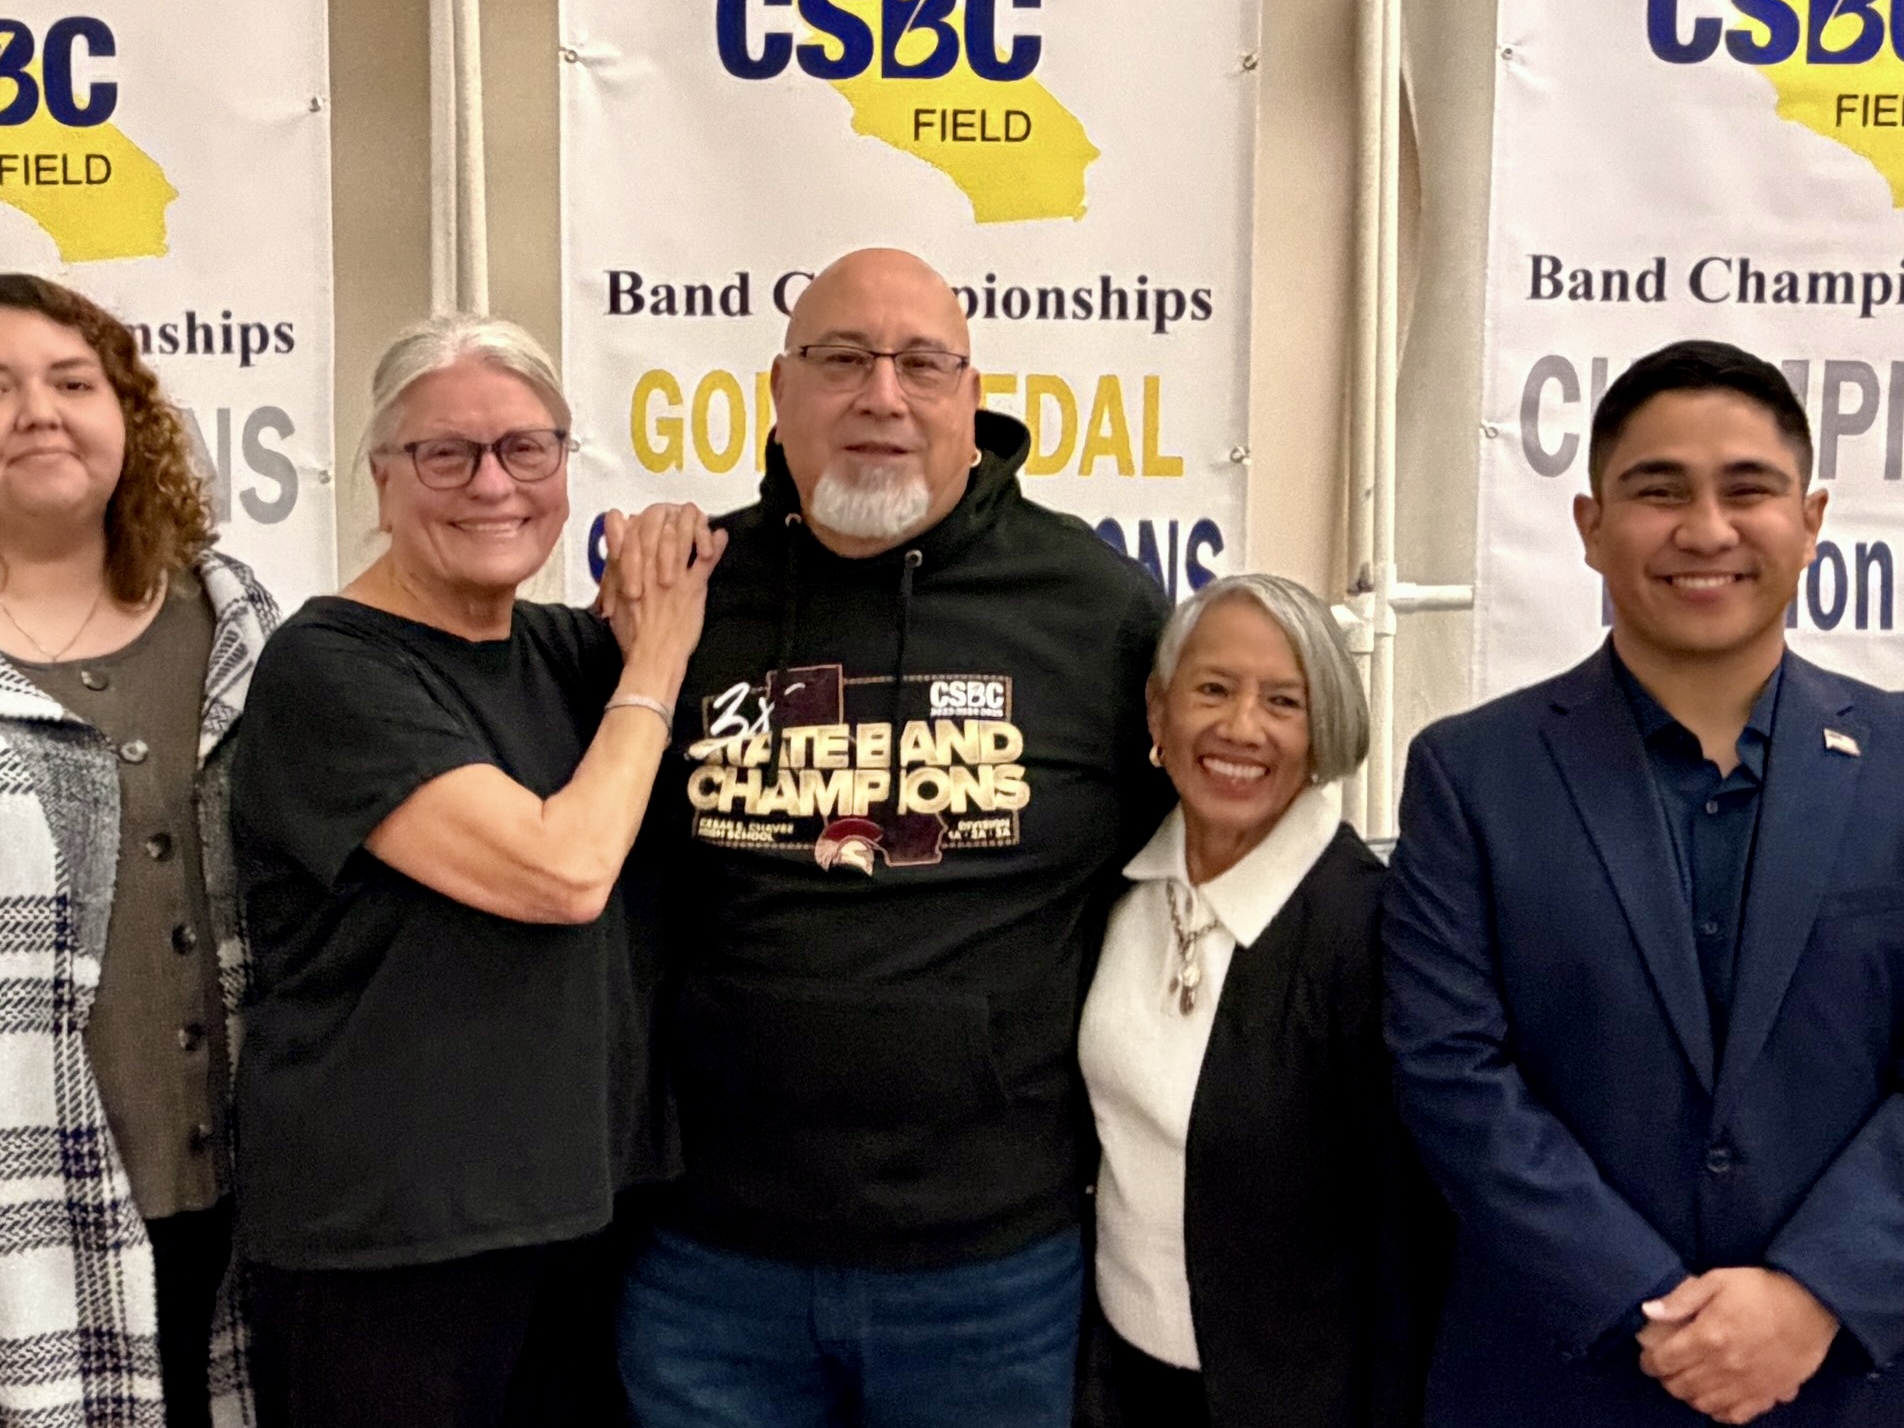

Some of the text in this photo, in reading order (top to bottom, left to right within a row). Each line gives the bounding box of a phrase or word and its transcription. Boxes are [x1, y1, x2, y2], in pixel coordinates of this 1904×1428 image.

[912, 108, 1033, 144] FIELD
[604, 269, 753, 319] Band
[1525, 253, 1668, 303] Band
[929, 680, 1005, 710] CSBC
[855, 719, 1024, 769] BAND
[687, 763, 1032, 816] CHAMPIONS
